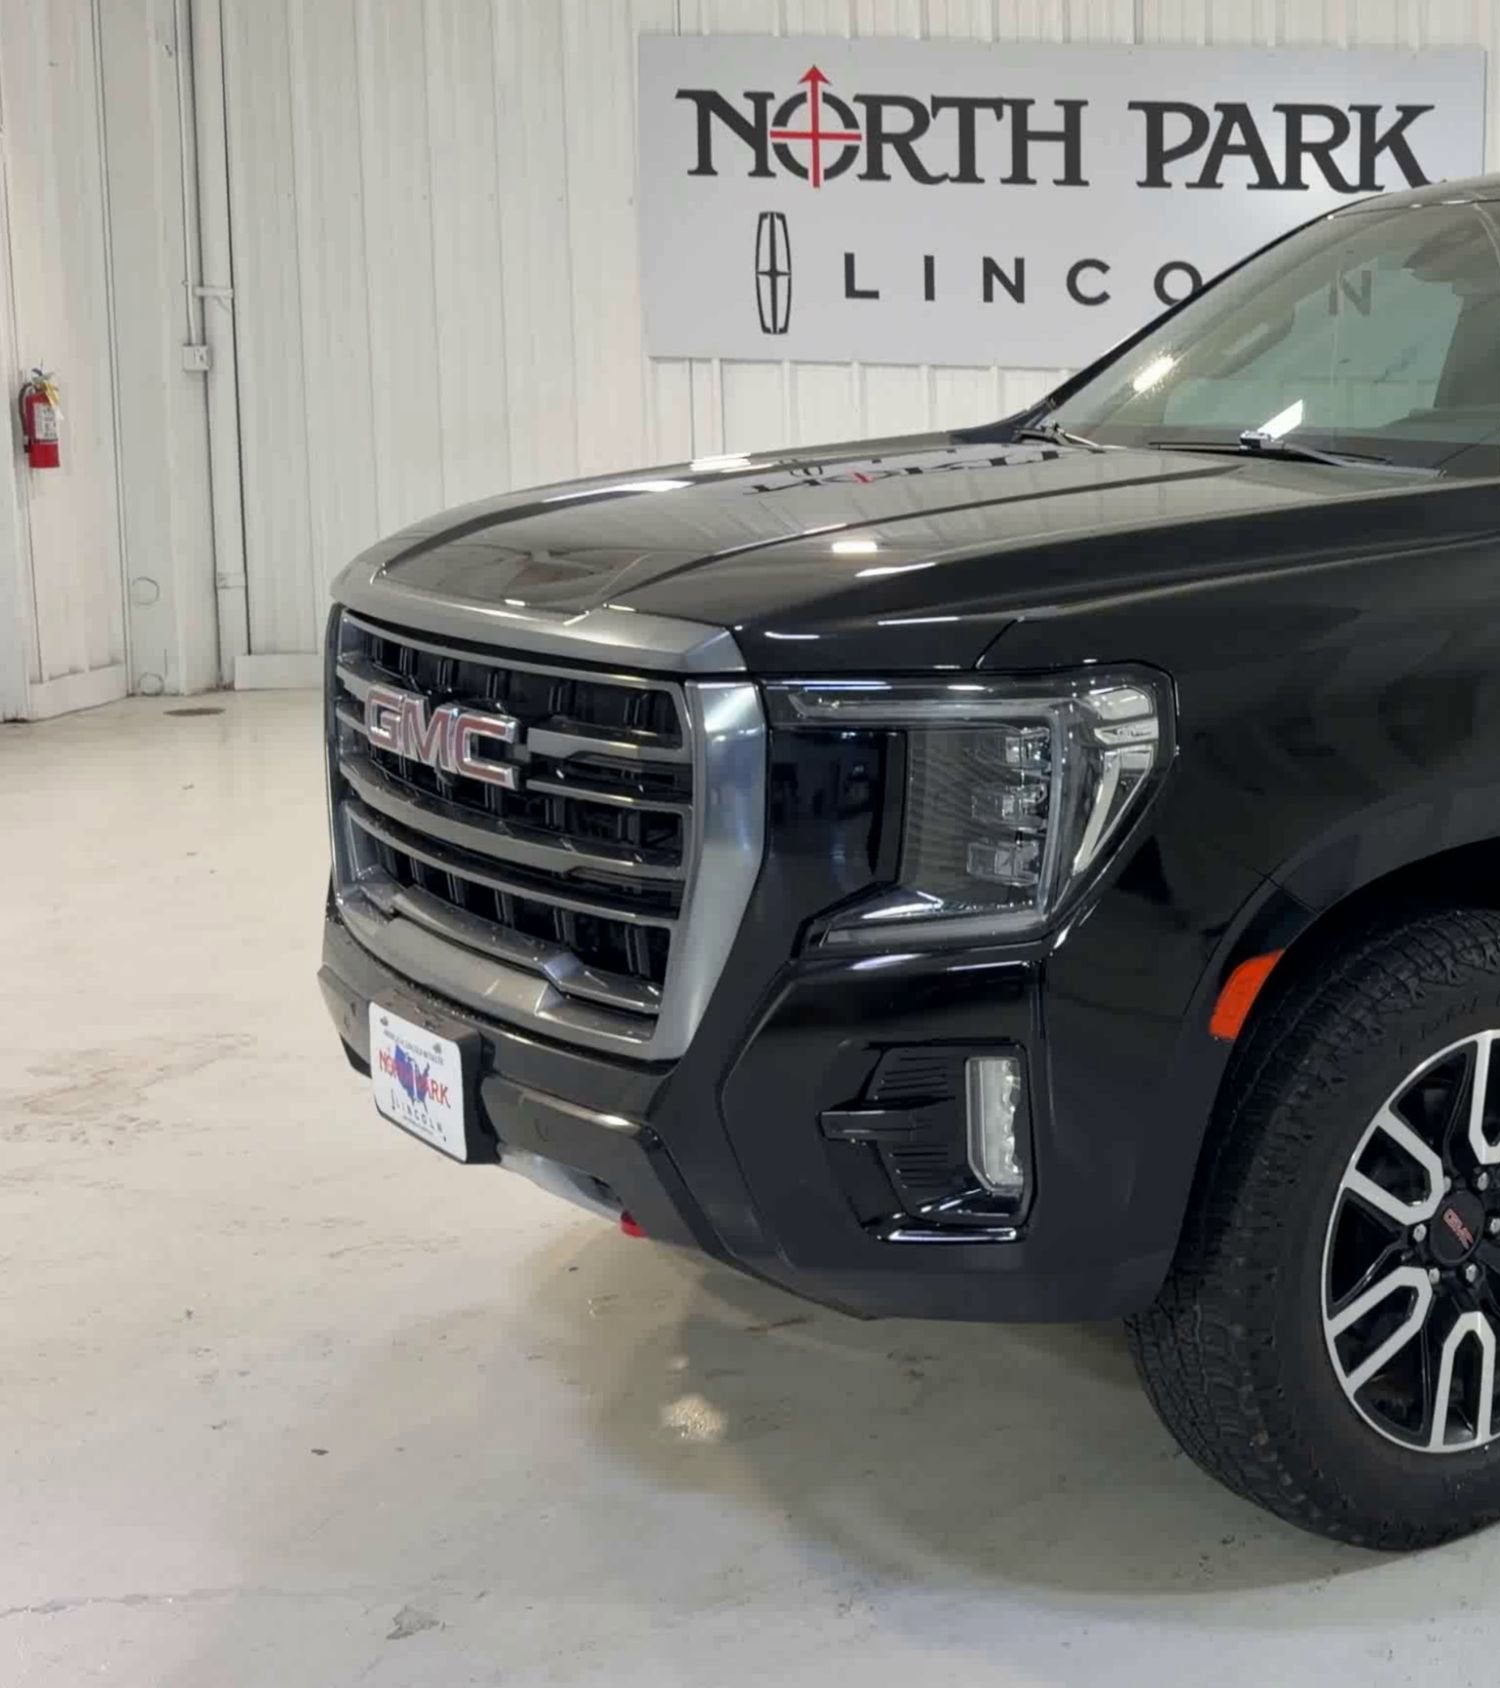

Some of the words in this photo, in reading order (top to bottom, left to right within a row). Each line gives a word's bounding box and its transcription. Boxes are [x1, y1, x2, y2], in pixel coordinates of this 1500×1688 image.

[675, 88, 1090, 188] NORTH
[1128, 101, 1436, 194] PARK
[844, 252, 1372, 316] LINCON
[367, 685, 519, 790] GMC
